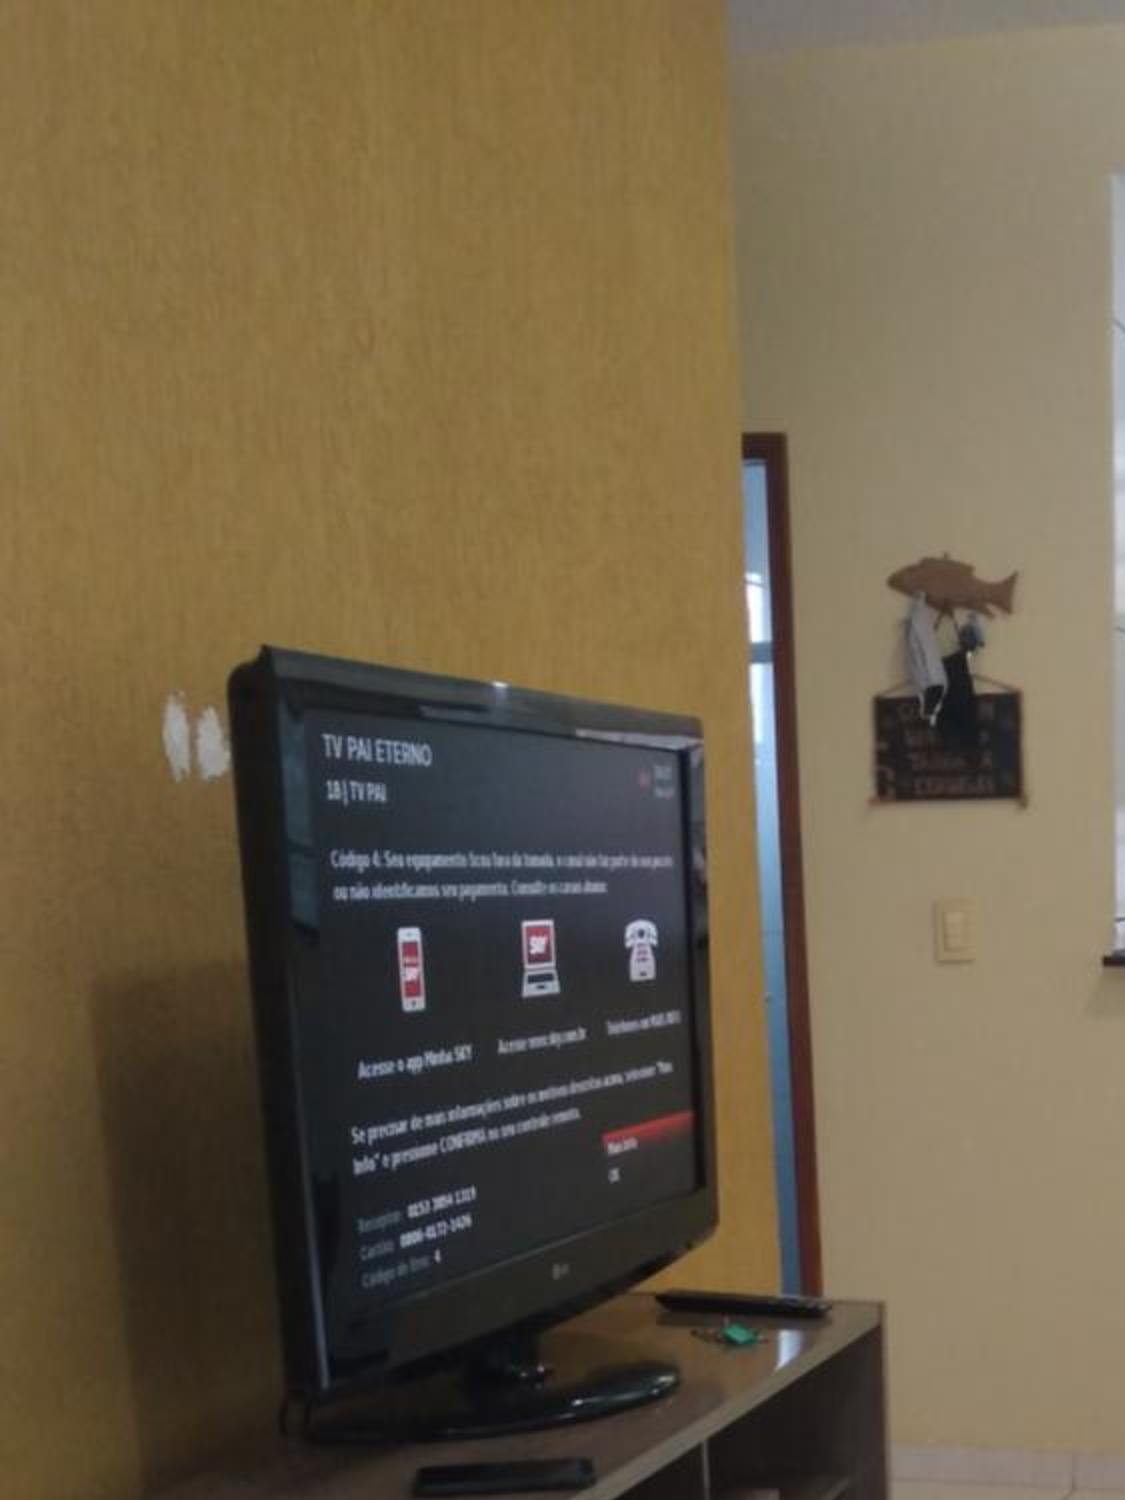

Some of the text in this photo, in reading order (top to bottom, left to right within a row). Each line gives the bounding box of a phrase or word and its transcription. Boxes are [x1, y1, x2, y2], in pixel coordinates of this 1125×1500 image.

[322, 734, 433, 767] TV PAI ETERNO
[350, 781, 365, 801] TV
[367, 782, 387, 802] PAI
[331, 850, 371, 874] Código
[384, 850, 404, 868] Seu
[357, 1056, 395, 1079] Acesse
[351, 1126, 366, 1145] Se
